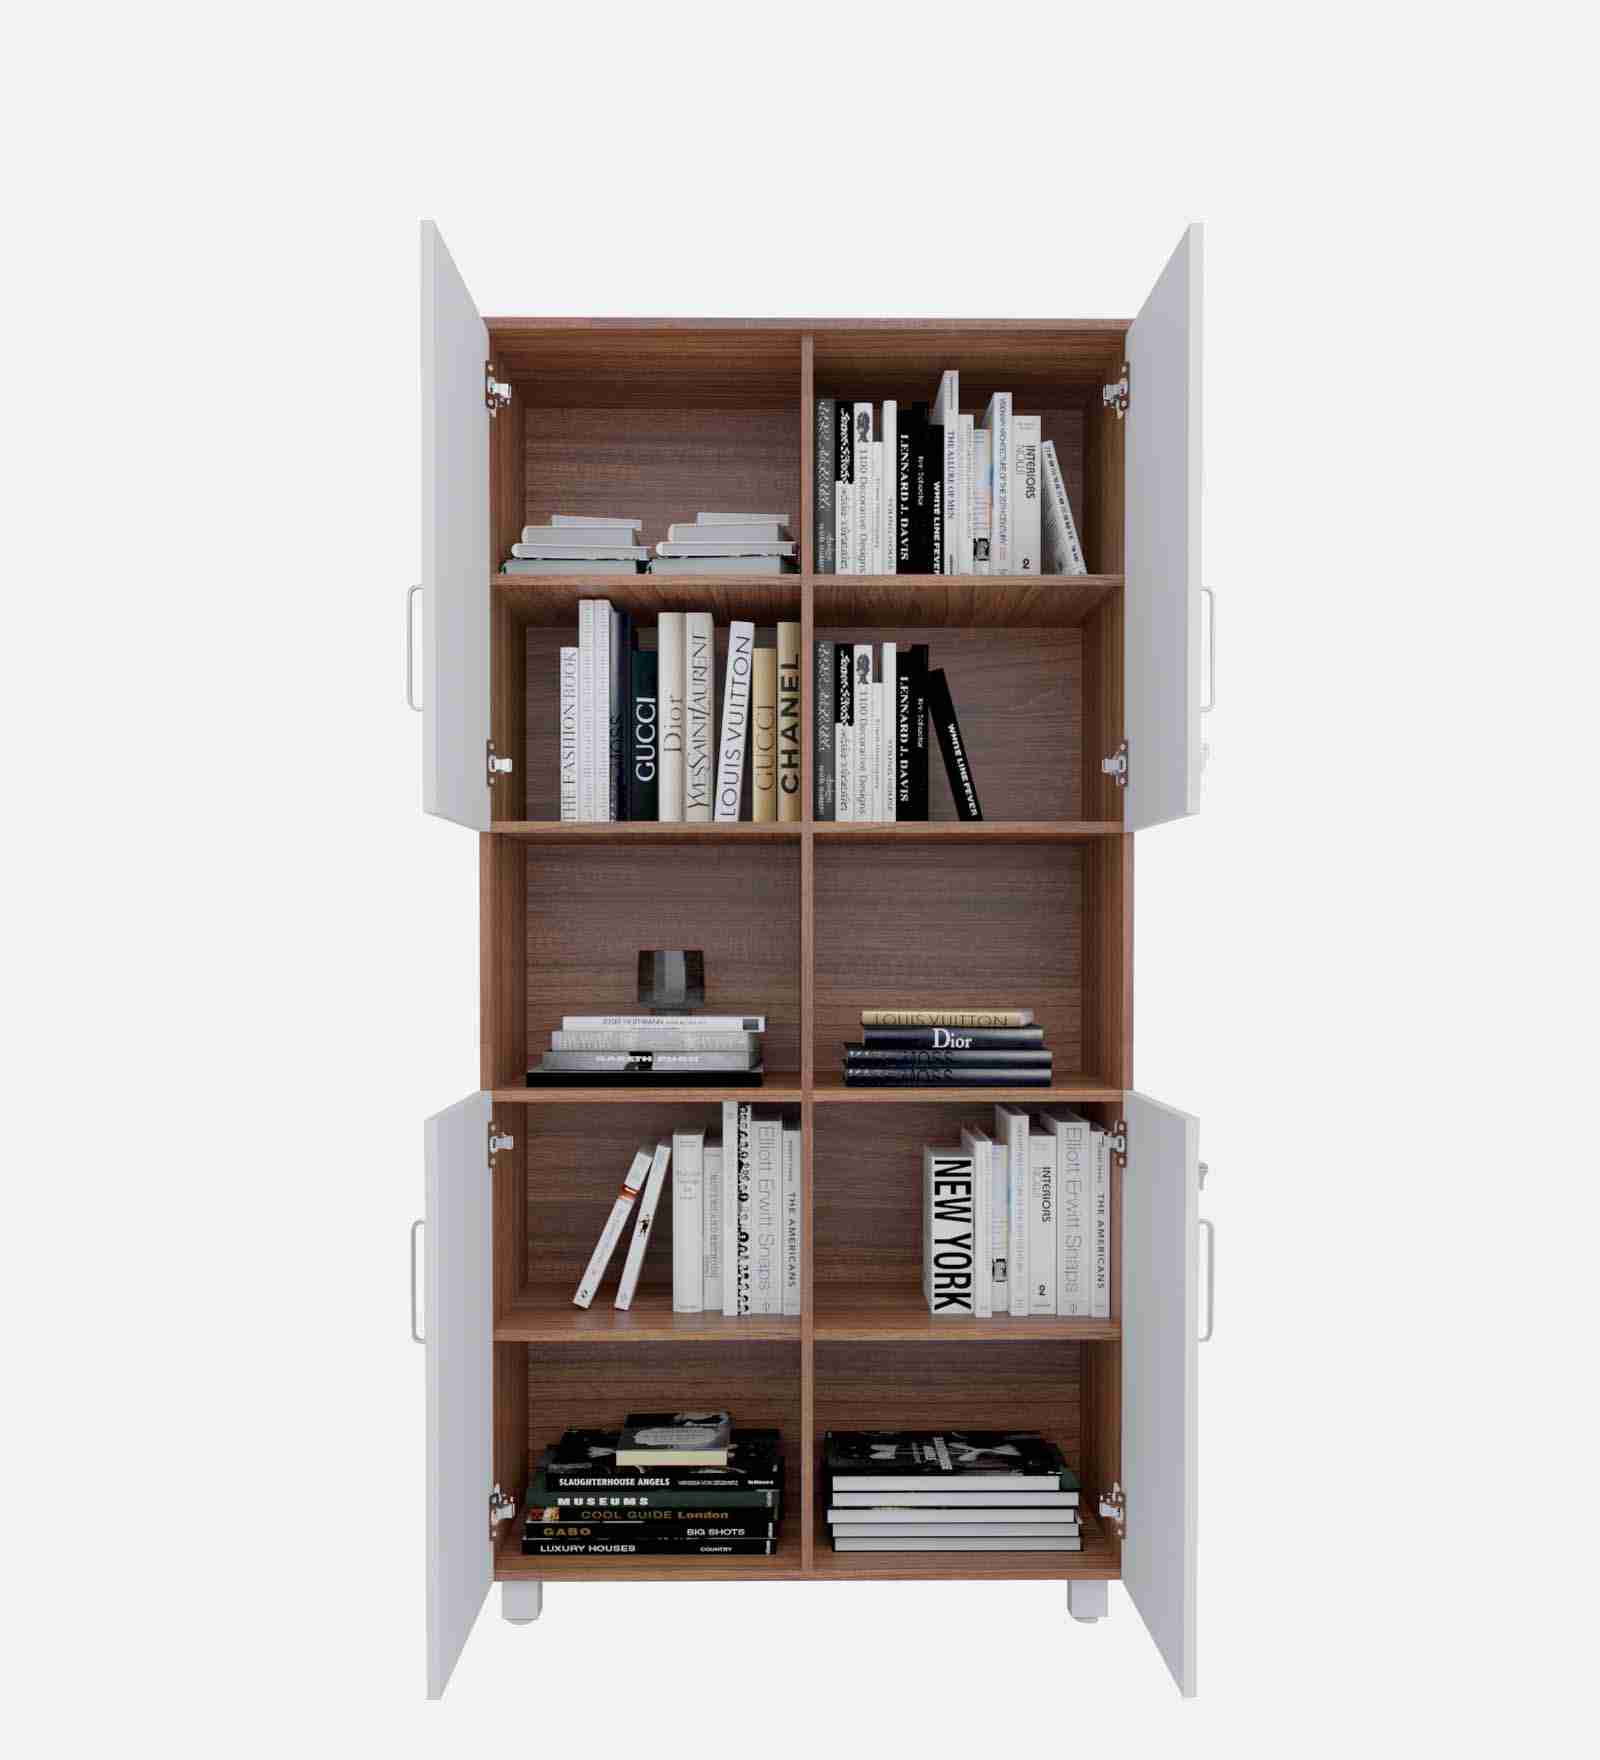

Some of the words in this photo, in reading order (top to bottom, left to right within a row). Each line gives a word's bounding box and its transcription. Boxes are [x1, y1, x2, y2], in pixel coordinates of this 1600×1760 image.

[947, 431, 956, 449] THE
[900, 433, 910, 501] LENNARD
[947, 450, 956, 484] ALLURE
[1025, 444, 1036, 499] INTERIORS
[900, 503, 910, 515] J.
[933, 481, 941, 514] WHITE
[947, 486, 956, 498] OF
[947, 500, 956, 520] MEN
[900, 518, 910, 561] DAVIS
[933, 517, 941, 541] LINE
[857, 534, 868, 573] Designs
[1022, 558, 1030, 569] 2
[562, 651, 577, 698] BOOK
[727, 635, 751, 742] VUITTON
[663, 694, 683, 752] Dior
[781, 654, 799, 793] CHANEL
[900, 676, 909, 743] LENNARD
[562, 704, 577, 785] FASHION
[635, 697, 656, 782] GUCCI
[755, 705, 775, 791] GUCCI
[900, 745, 909, 757] J.
[719, 749, 742, 817] LOUIS
[900, 760, 909, 802] DAVIS
[947, 723, 962, 757] WHITE
[956, 758, 968, 782] LINE
[962, 781, 978, 817] FEVER
[856, 774, 869, 815] Designs
[873, 1014, 925, 1025] LOUIS
[927, 1014, 1008, 1026] VUITTON
[932, 1027, 973, 1049] Dior
[758, 1126, 776, 1171] Elliott
[1065, 1127, 1082, 1174] Elliott
[758, 1178, 776, 1226] Erwitt
[787, 1192, 796, 1215] THE
[934, 1159, 972, 1224] NEW
[1041, 1167, 1052, 1223] INTERIORS
[1065, 1179, 1082, 1228] Erwitt
[1096, 1193, 1105, 1214] THE
[753, 1233, 776, 1290] Snaps
[787, 1219, 796, 1288] AMERICANS
[933, 1232, 973, 1310] YORK
[1063, 1234, 1082, 1293] Snaps
[1096, 1219, 1105, 1289] AMERICANS
[1039, 1284, 1046, 1296] 2
[557, 1497, 649, 1506] MUSEUMS
[558, 1477, 636, 1486] SLAUGHTERHOUSE
[637, 1477, 670, 1486] ANGELS
[543, 1527, 592, 1536] GABO
[580, 1511, 622, 1520] COOL
[627, 1510, 673, 1520] GUIDE
[677, 1510, 729, 1520] London
[686, 1528, 706, 1537] BIG
[708, 1528, 745, 1537] SHOTS
[540, 1544, 585, 1553] LUXURY
[588, 1544, 636, 1553] HOUSES
